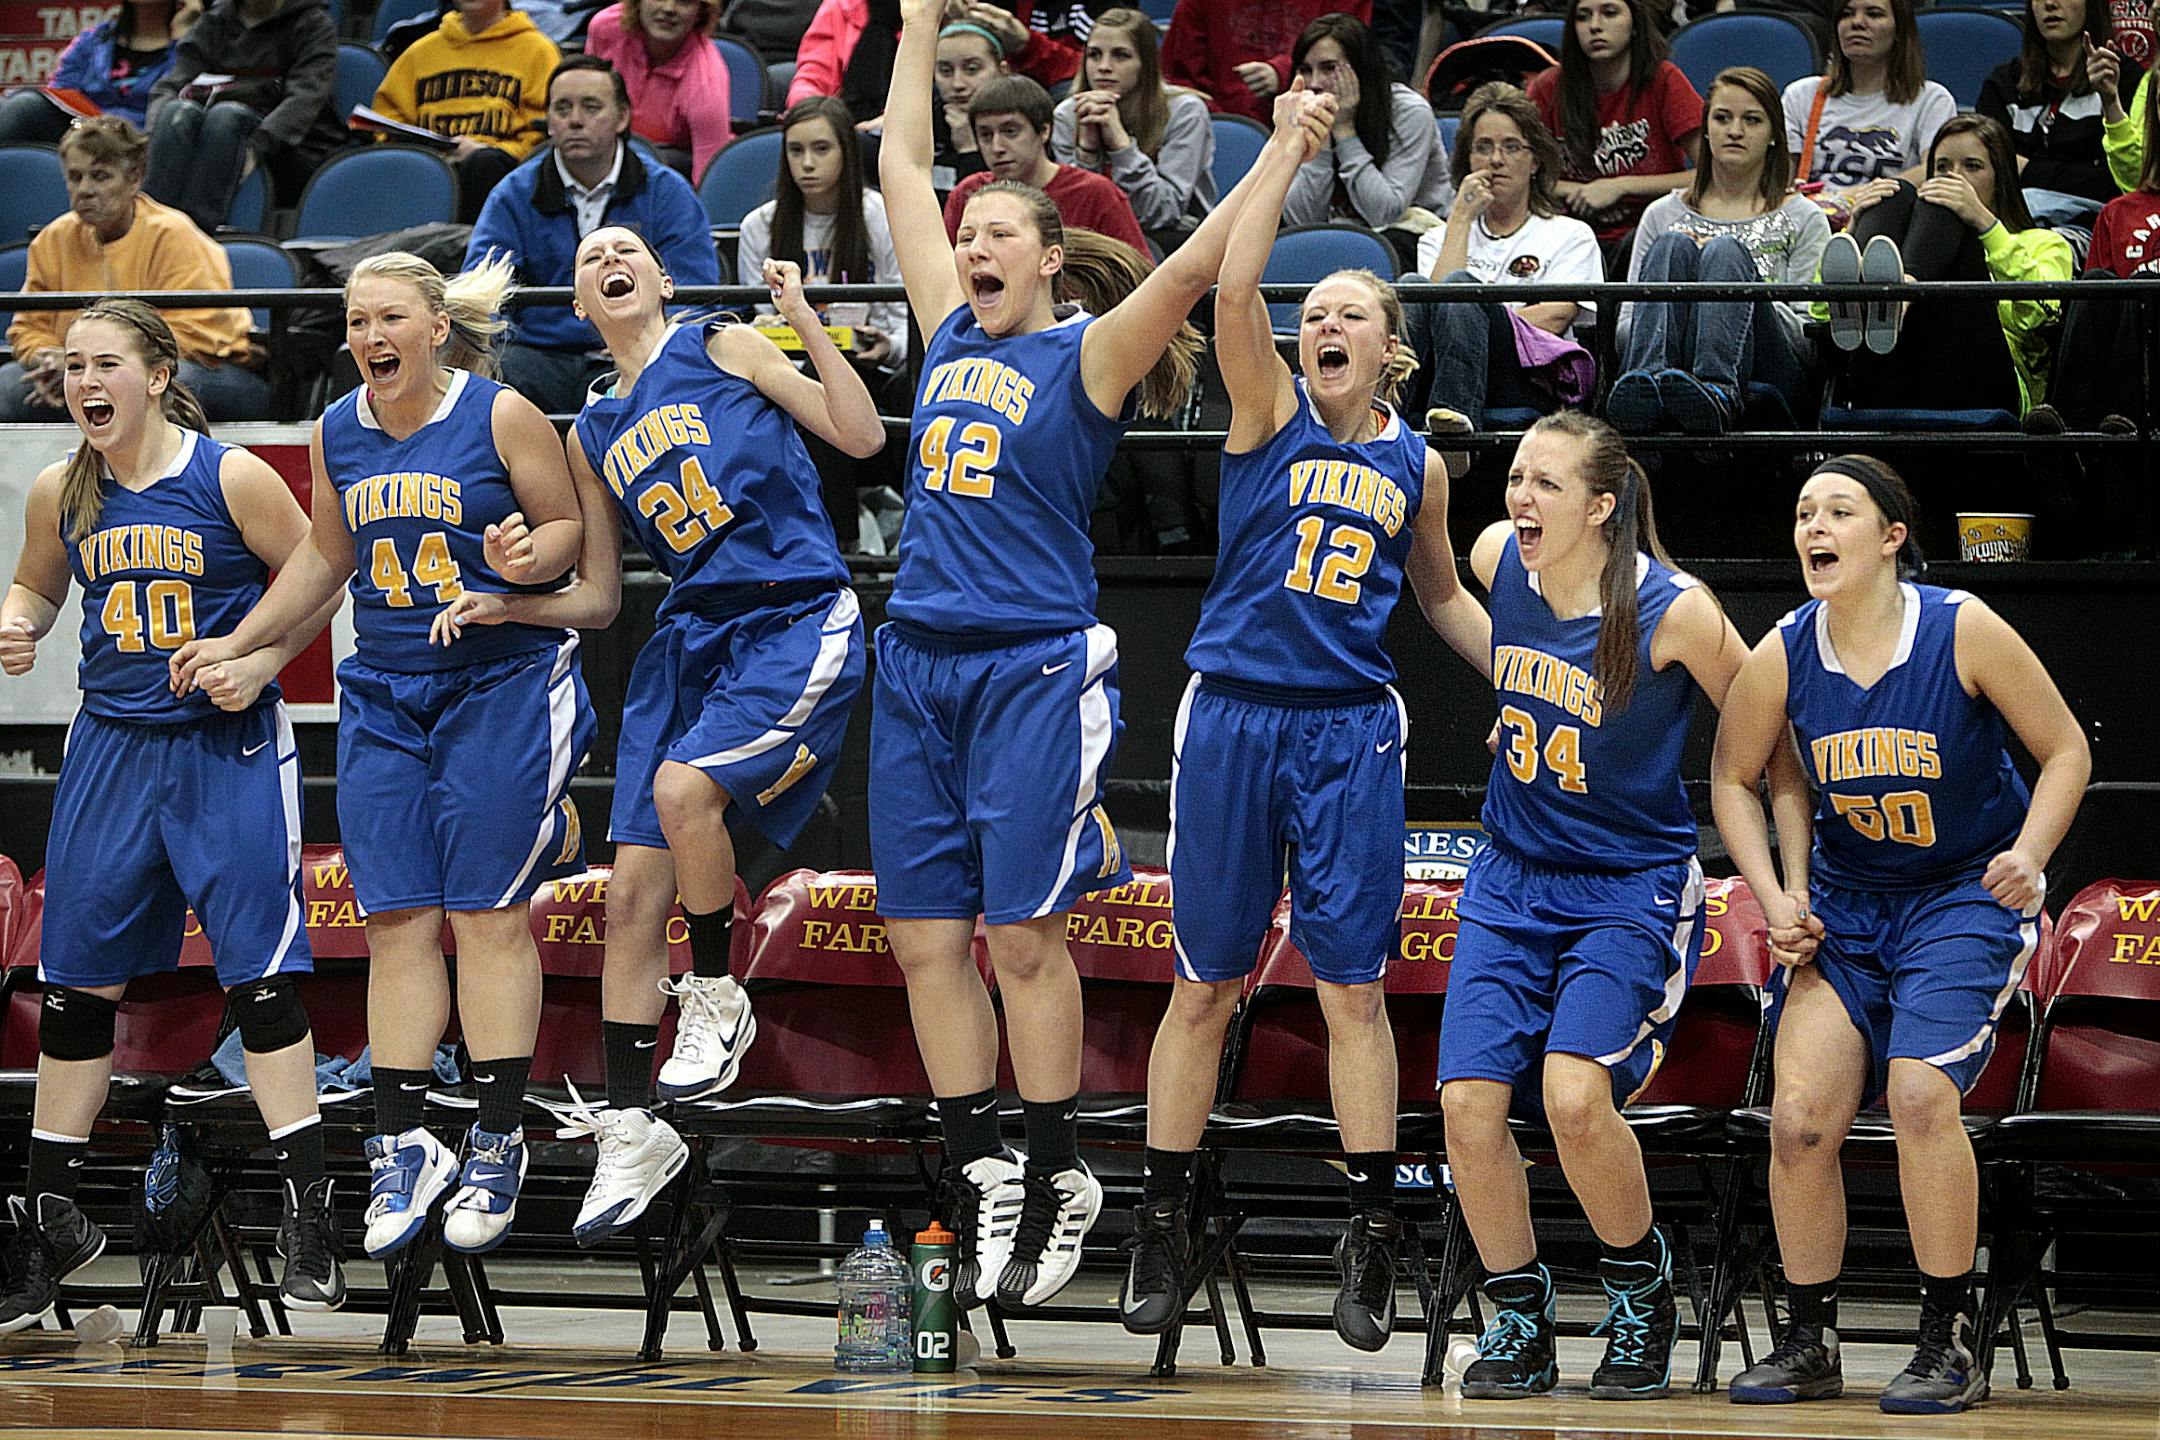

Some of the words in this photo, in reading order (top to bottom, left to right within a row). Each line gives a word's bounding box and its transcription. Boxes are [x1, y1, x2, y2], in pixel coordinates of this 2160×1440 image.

[922, 357, 1035, 426] VIKINGS
[603, 403, 711, 500] VIKINGS
[919, 415, 1002, 498] 42
[345, 472, 463, 533] VIKINGS
[637, 455, 735, 553] 24
[1289, 459, 1407, 538] VIKINGS
[79, 524, 204, 582] VIKINGS
[370, 531, 465, 607] 44
[1284, 515, 1376, 604] 12
[101, 580, 196, 652] 40
[1494, 645, 1606, 728] VIKINGS
[1501, 704, 1588, 794] 34
[1811, 727, 1942, 784] VIKINGS
[1404, 832, 1486, 859] NES
[1829, 790, 1936, 847] 50
